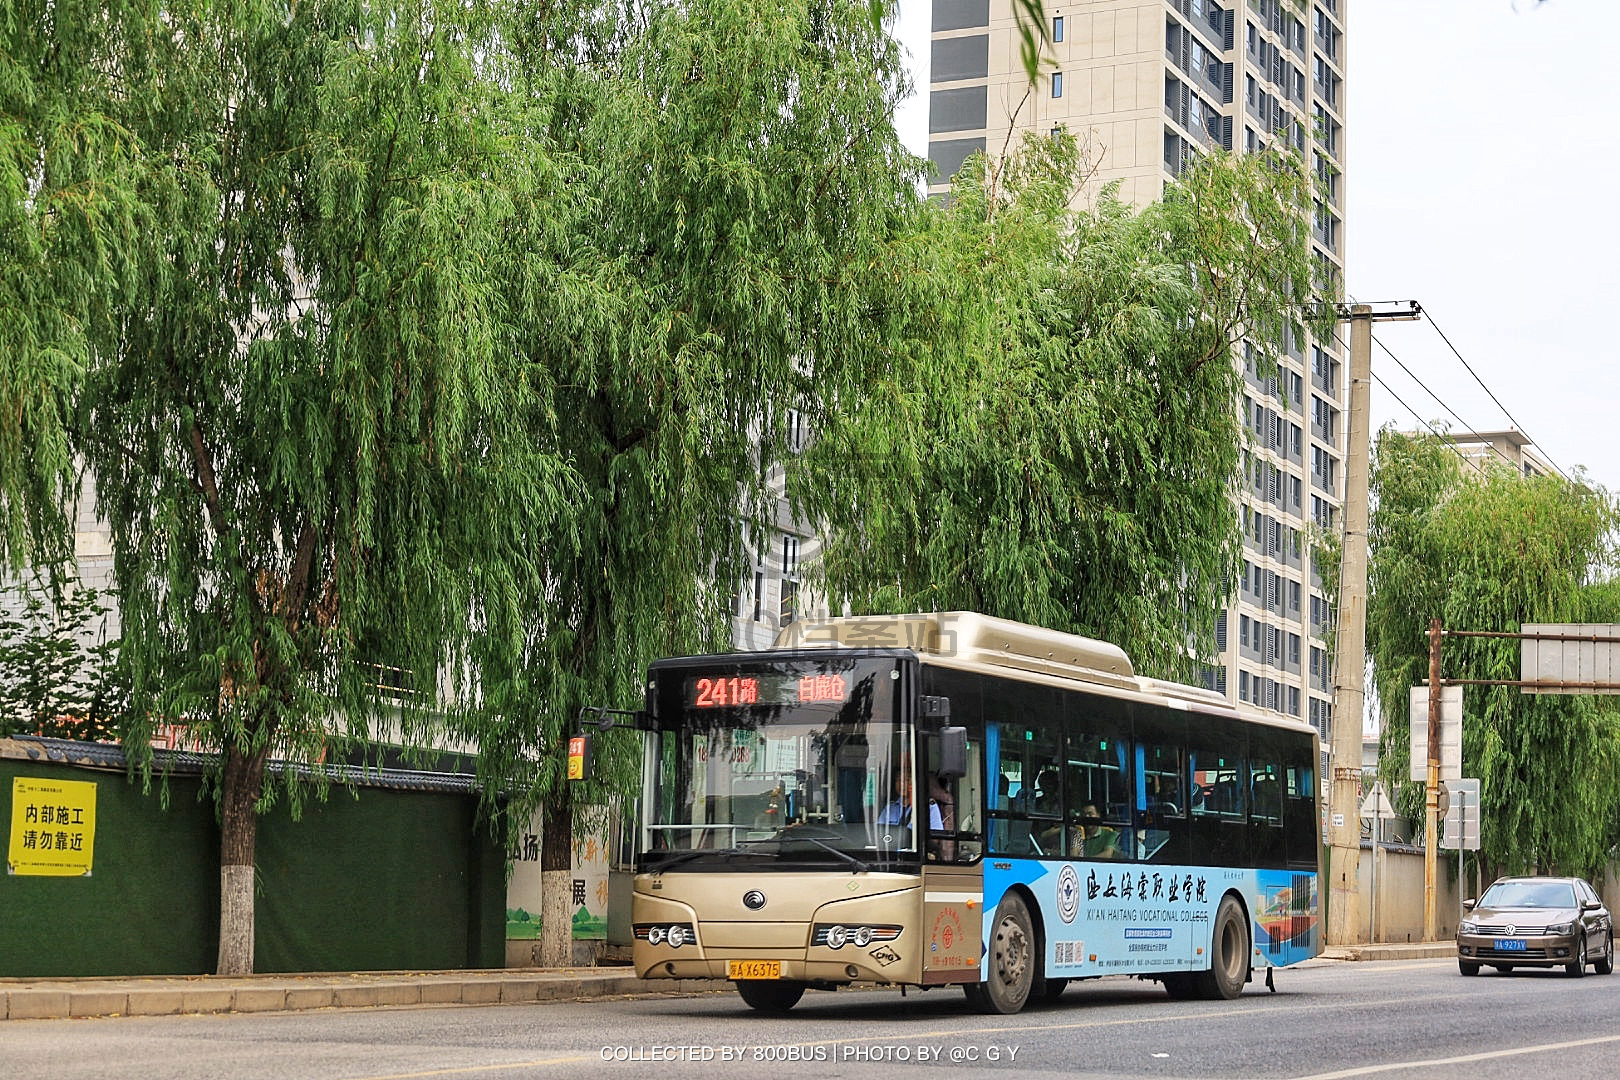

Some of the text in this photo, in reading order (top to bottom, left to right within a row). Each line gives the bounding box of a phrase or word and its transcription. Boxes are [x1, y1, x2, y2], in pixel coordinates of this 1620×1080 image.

[696, 677, 758, 706] 241路
[25, 803, 84, 825] 内部施工
[23, 830, 84, 851] 请勿靠近
[1087, 908, 1208, 922] XI'AN HAITANG VOCATIONAL COLLEGE
[875, 951, 894, 961] CNG
